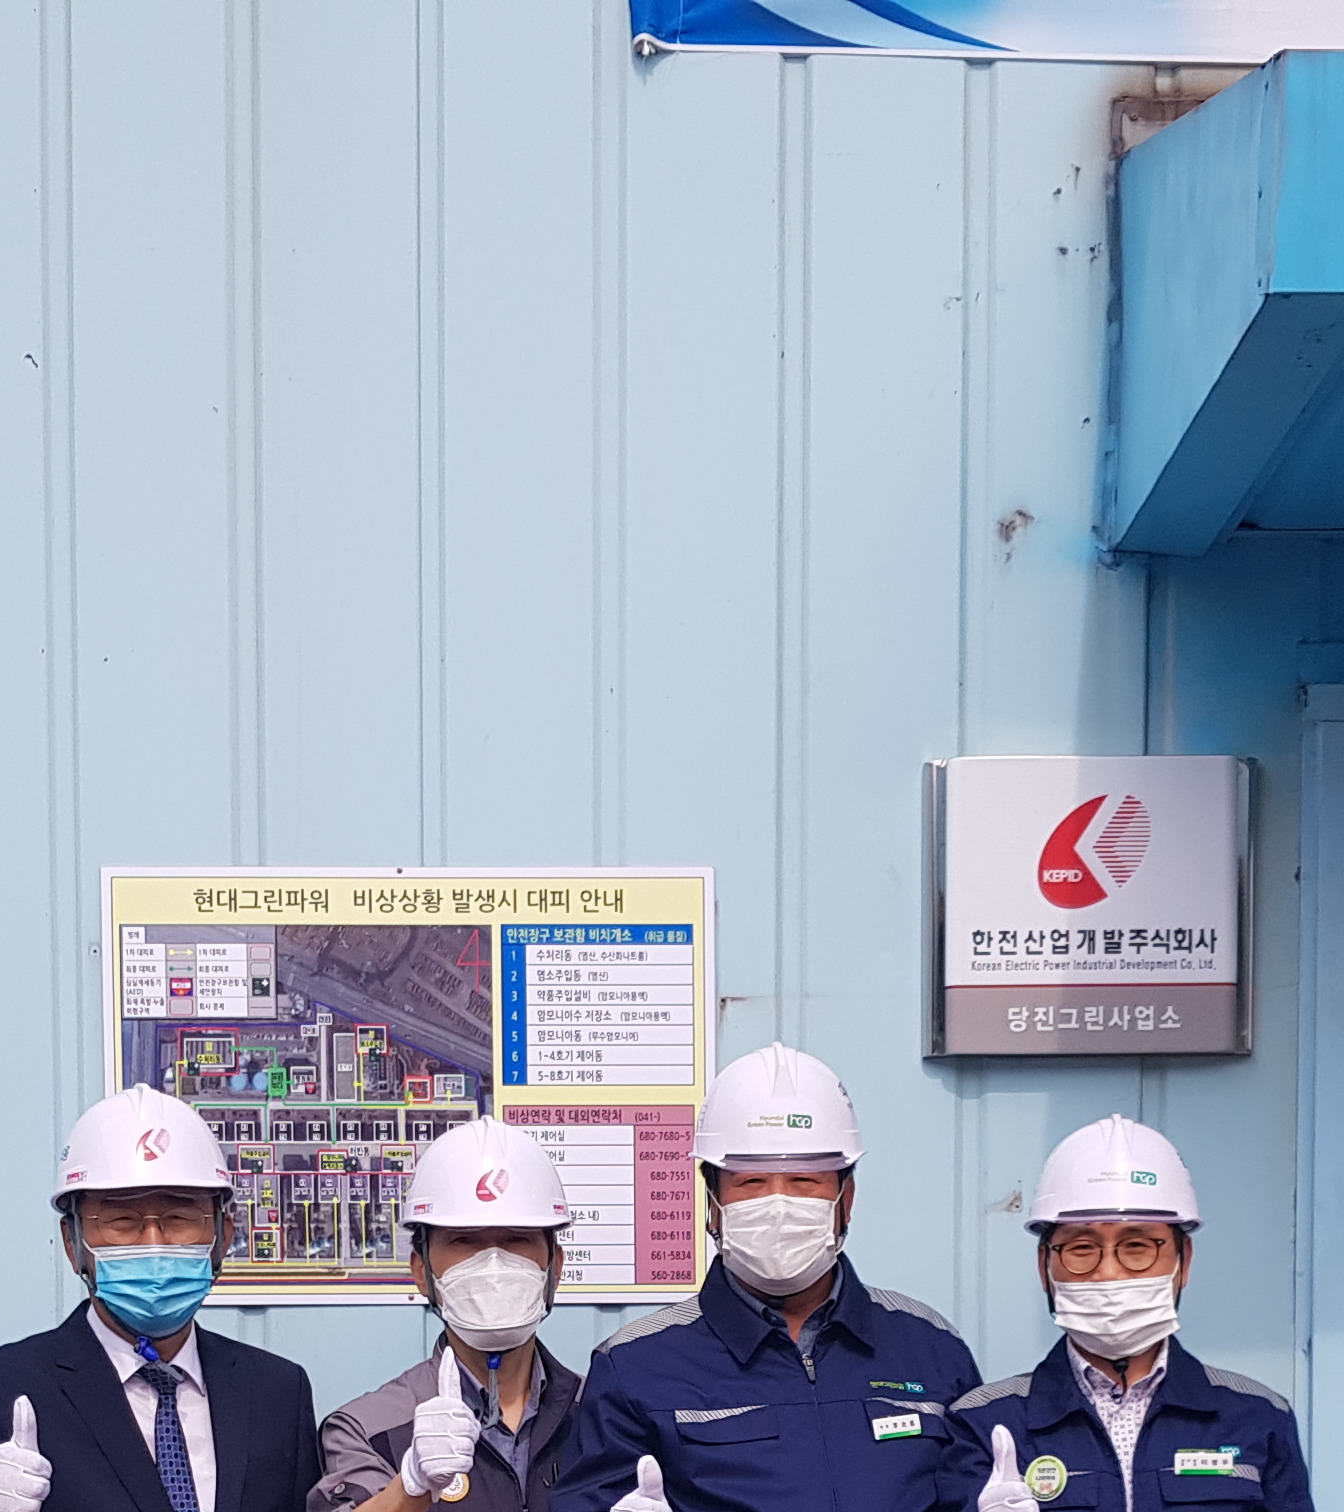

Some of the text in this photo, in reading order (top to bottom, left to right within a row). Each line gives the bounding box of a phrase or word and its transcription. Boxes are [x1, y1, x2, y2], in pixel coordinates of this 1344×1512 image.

[1043, 869, 1084, 883] KEPID
[193, 888, 624, 914] 현대그린파워 비상상황 발생시 대피 안내
[506, 928, 551, 943] 안전장구
[554, 928, 586, 943] 보관함
[589, 928, 633, 943] 비치개소
[971, 927, 1218, 956] 한전산업개발주식회사
[511, 950, 517, 961] 1
[536, 949, 573, 962] 수처리동
[971, 960, 1003, 972] Korean
[1005, 959, 1040, 972] Electric
[1043, 959, 1071, 972] Power
[1073, 959, 1117, 971] Industrial
[1120, 958, 1178, 972] Development
[511, 970, 518, 982] 2
[537, 969, 582, 982] 염소주입동
[511, 990, 518, 1002] 3
[511, 1010, 518, 1022] 4
[537, 1010, 583, 1022] 암모니아수
[585, 1010, 613, 1022] 저장소
[1007, 1005, 1182, 1033] 당진그린사업소
[511, 1030, 518, 1042] 5
[537, 1030, 583, 1042] 암모니아동
[512, 1051, 519, 1063] 6
[576, 1050, 604, 1063] 제어동
[512, 1071, 519, 1083] 7
[576, 1070, 604, 1083] 제어동
[508, 1108, 661, 1124] 비상연락 및 대외연락처 (041-)
[546, 1150, 566, 1162] 어실
[650, 1171, 691, 1182] 680-7551
[650, 1191, 691, 1202] 680-7671
[650, 1211, 692, 1222] 680-6119
[650, 1231, 692, 1241] 680-6118
[564, 1250, 592, 1262] 방센터
[650, 1251, 692, 1261] 661-5834
[650, 1270, 692, 1281] 560-2868
